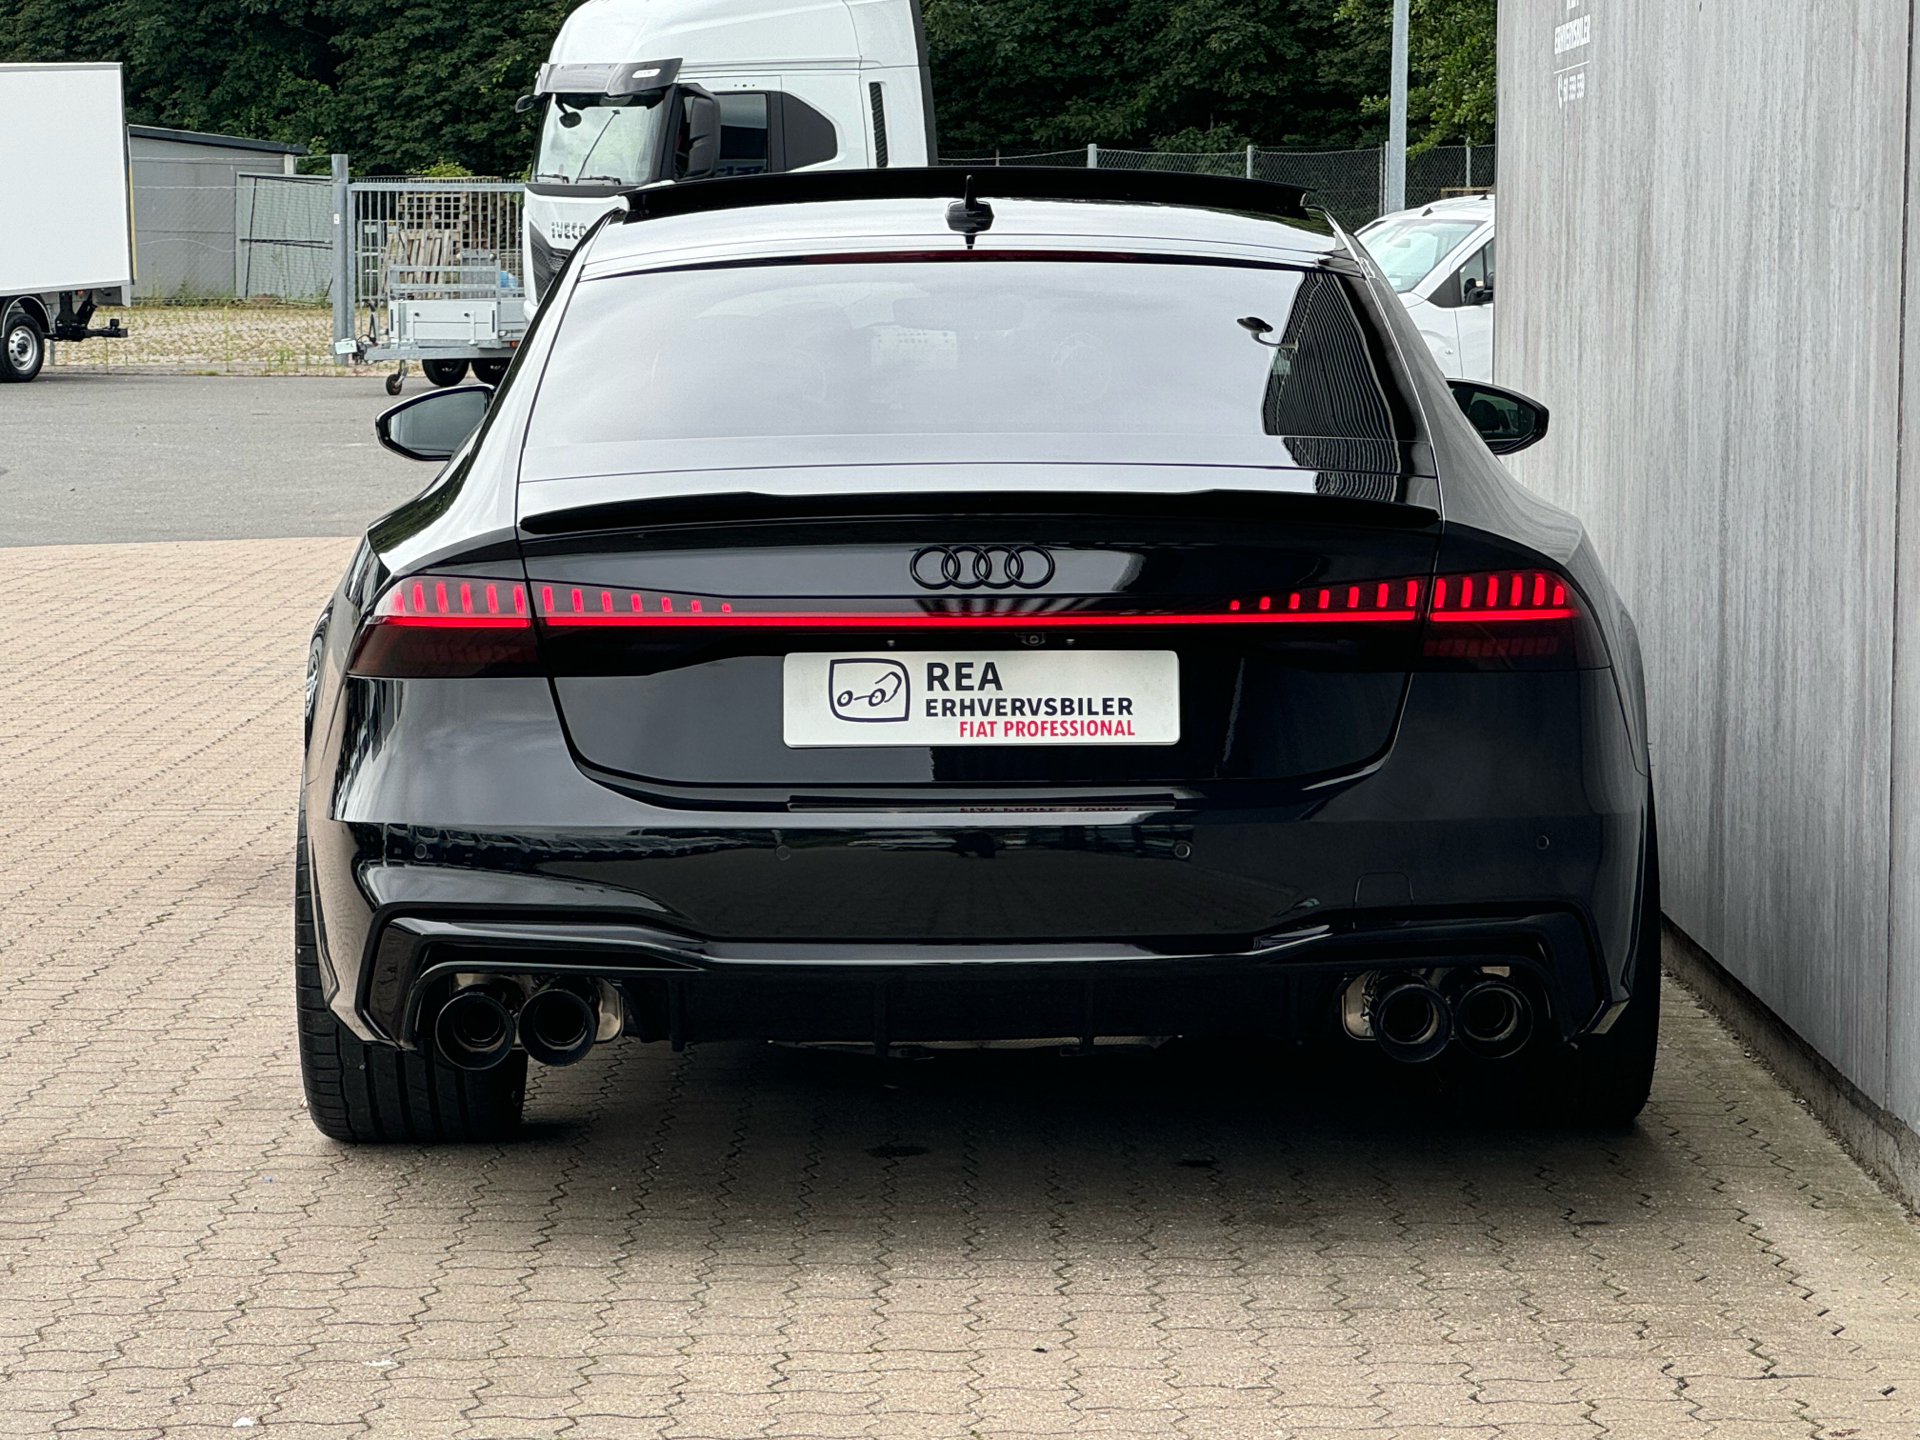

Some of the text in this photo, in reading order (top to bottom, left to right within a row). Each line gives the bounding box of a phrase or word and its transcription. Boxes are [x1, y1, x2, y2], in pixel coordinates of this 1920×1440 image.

[551, 221, 587, 240] IVECO
[926, 661, 1004, 692] REA
[925, 697, 1134, 717] ERHVERVSBILER
[959, 719, 1136, 738] FIAT PROFESSIONAL
